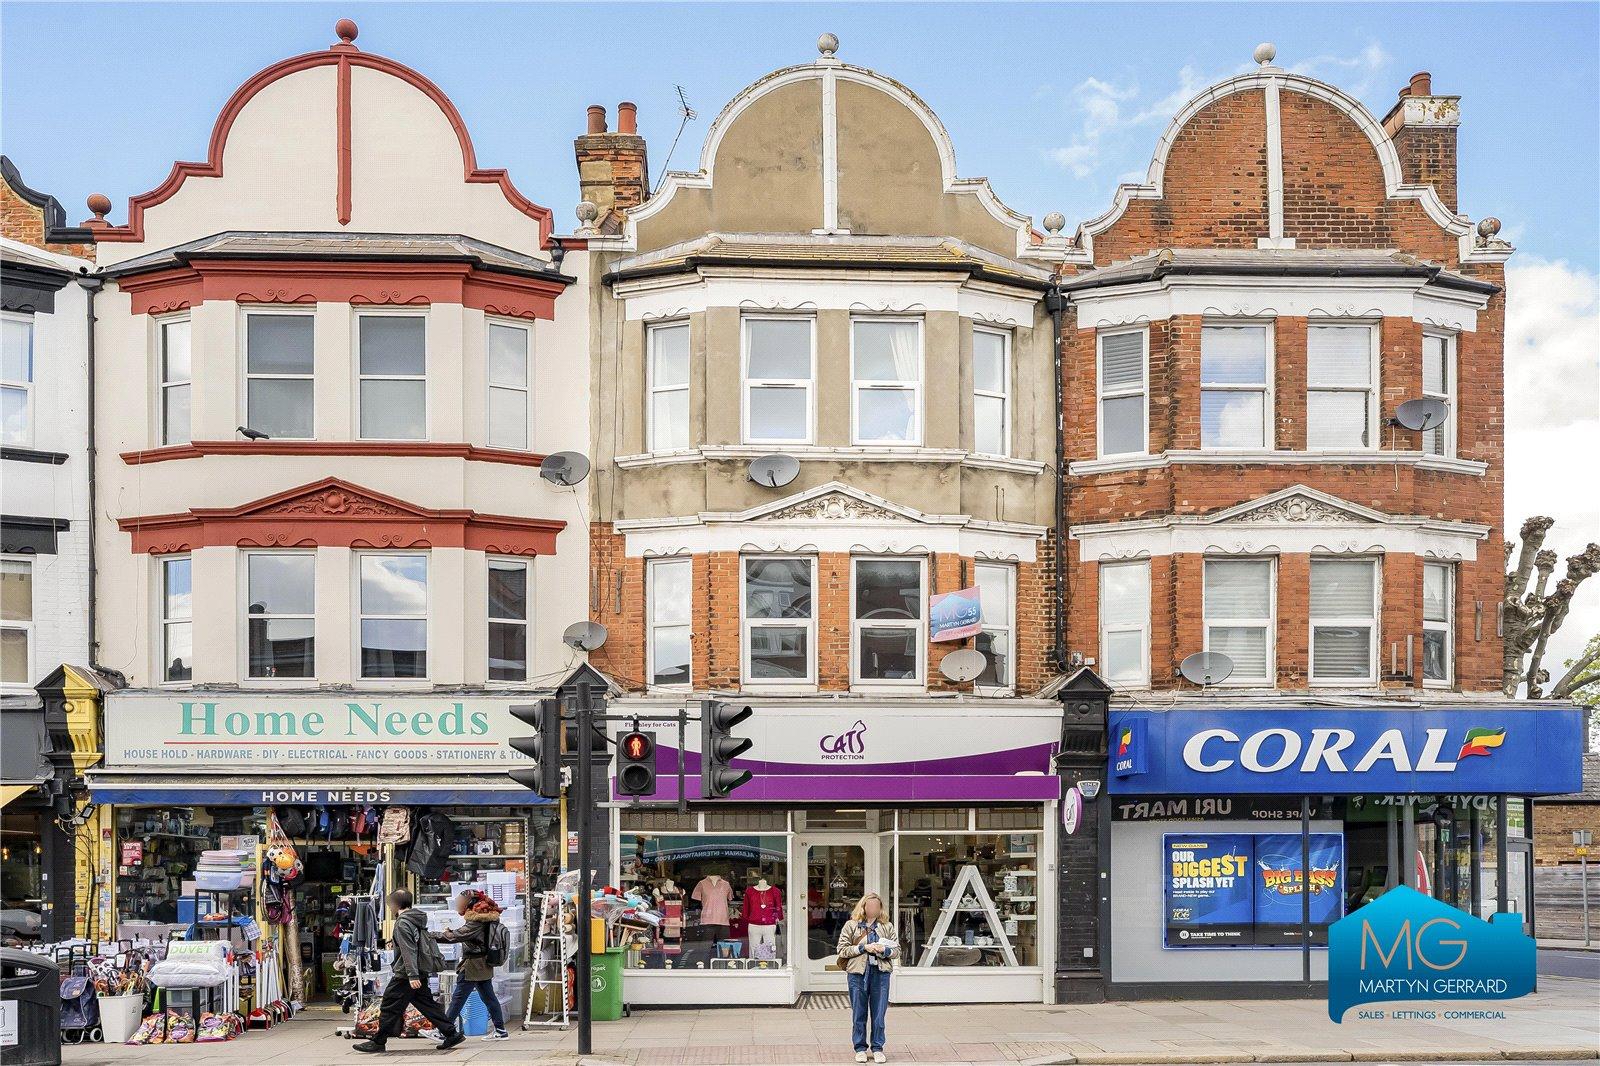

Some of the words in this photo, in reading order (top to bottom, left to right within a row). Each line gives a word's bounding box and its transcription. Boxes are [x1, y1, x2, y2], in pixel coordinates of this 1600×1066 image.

[177, 702, 325, 736] Home
[344, 702, 489, 736] Needs
[820, 719, 867, 754] CATS
[124, 749, 158, 759] HOUSE
[161, 749, 188, 759] HOLD
[196, 749, 253, 759] HARDWARE
[262, 749, 279, 759] DIY
[288, 749, 348, 759] ELECTRICAL
[356, 749, 388, 759] FANCY
[394, 750, 428, 760] GOODS
[436, 750, 496, 760] STATIONERY
[499, 750, 507, 760] &
[1182, 727, 1459, 773] CORAL
[1116, 759, 1133, 772] CORAL
[262, 791, 318, 802] HOME
[327, 791, 391, 802] NEEDS
[1172, 851, 1195, 862] OUR
[1172, 854, 1248, 878] BIGGEST
[1172, 877, 1214, 888] SPLASH
[1216, 876, 1235, 888] YET
[1263, 870, 1292, 888] BIG
[169, 944, 212, 955] DUVET
